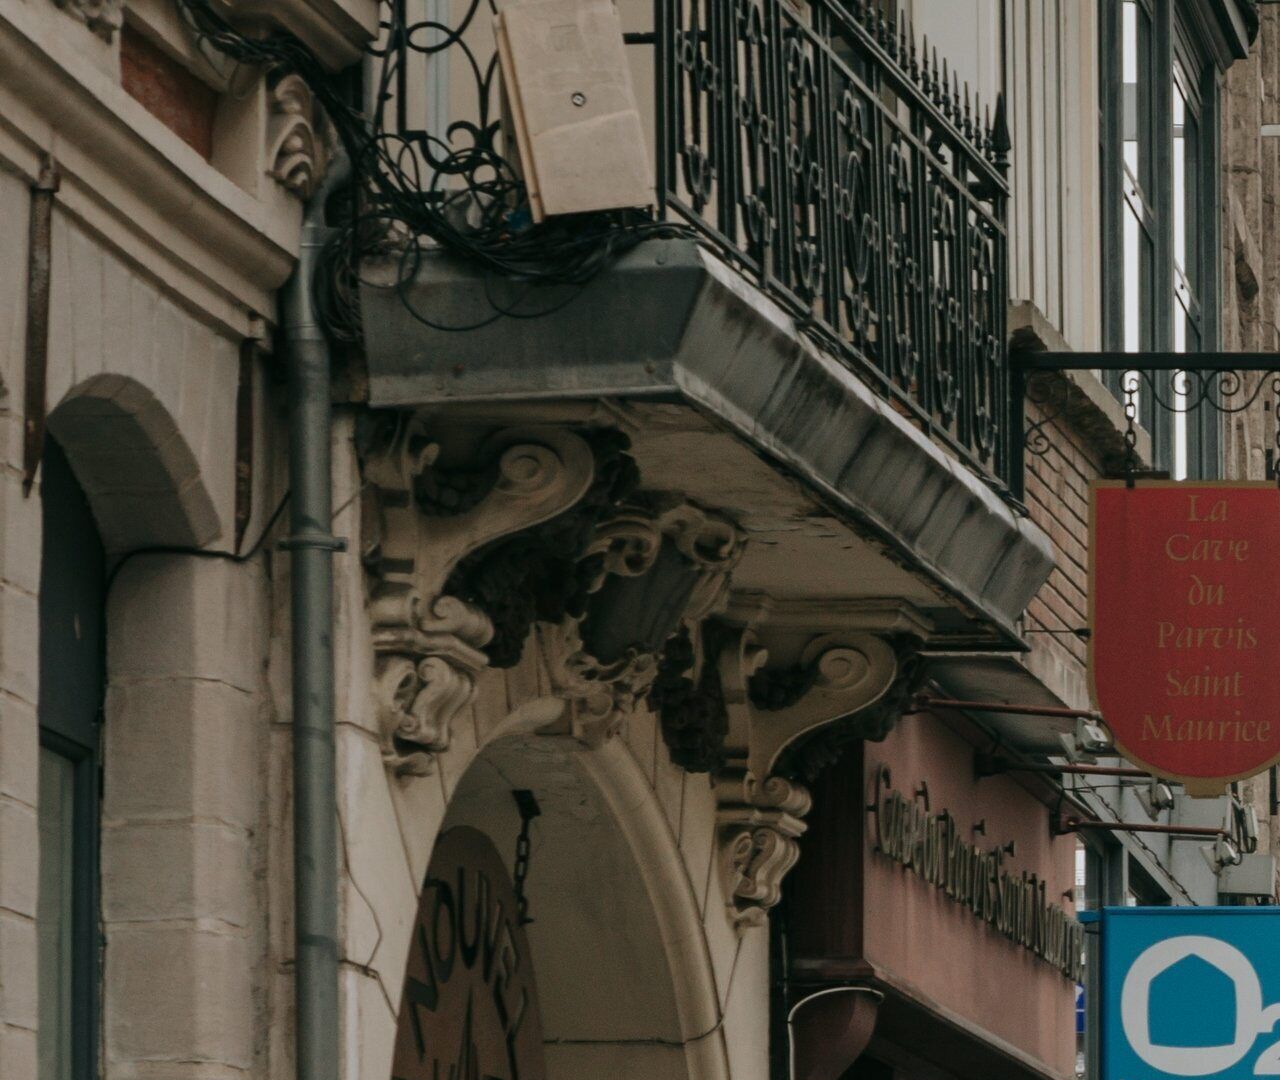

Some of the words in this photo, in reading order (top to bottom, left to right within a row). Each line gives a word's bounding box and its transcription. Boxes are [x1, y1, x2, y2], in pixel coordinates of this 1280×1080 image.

[1186, 493, 1229, 523] La
[1164, 533, 1250, 562] Cave
[1187, 575, 1226, 606] du
[1157, 616, 1258, 650] Parvis
[1165, 668, 1244, 698] Saint
[1141, 713, 1272, 743] Maurice
